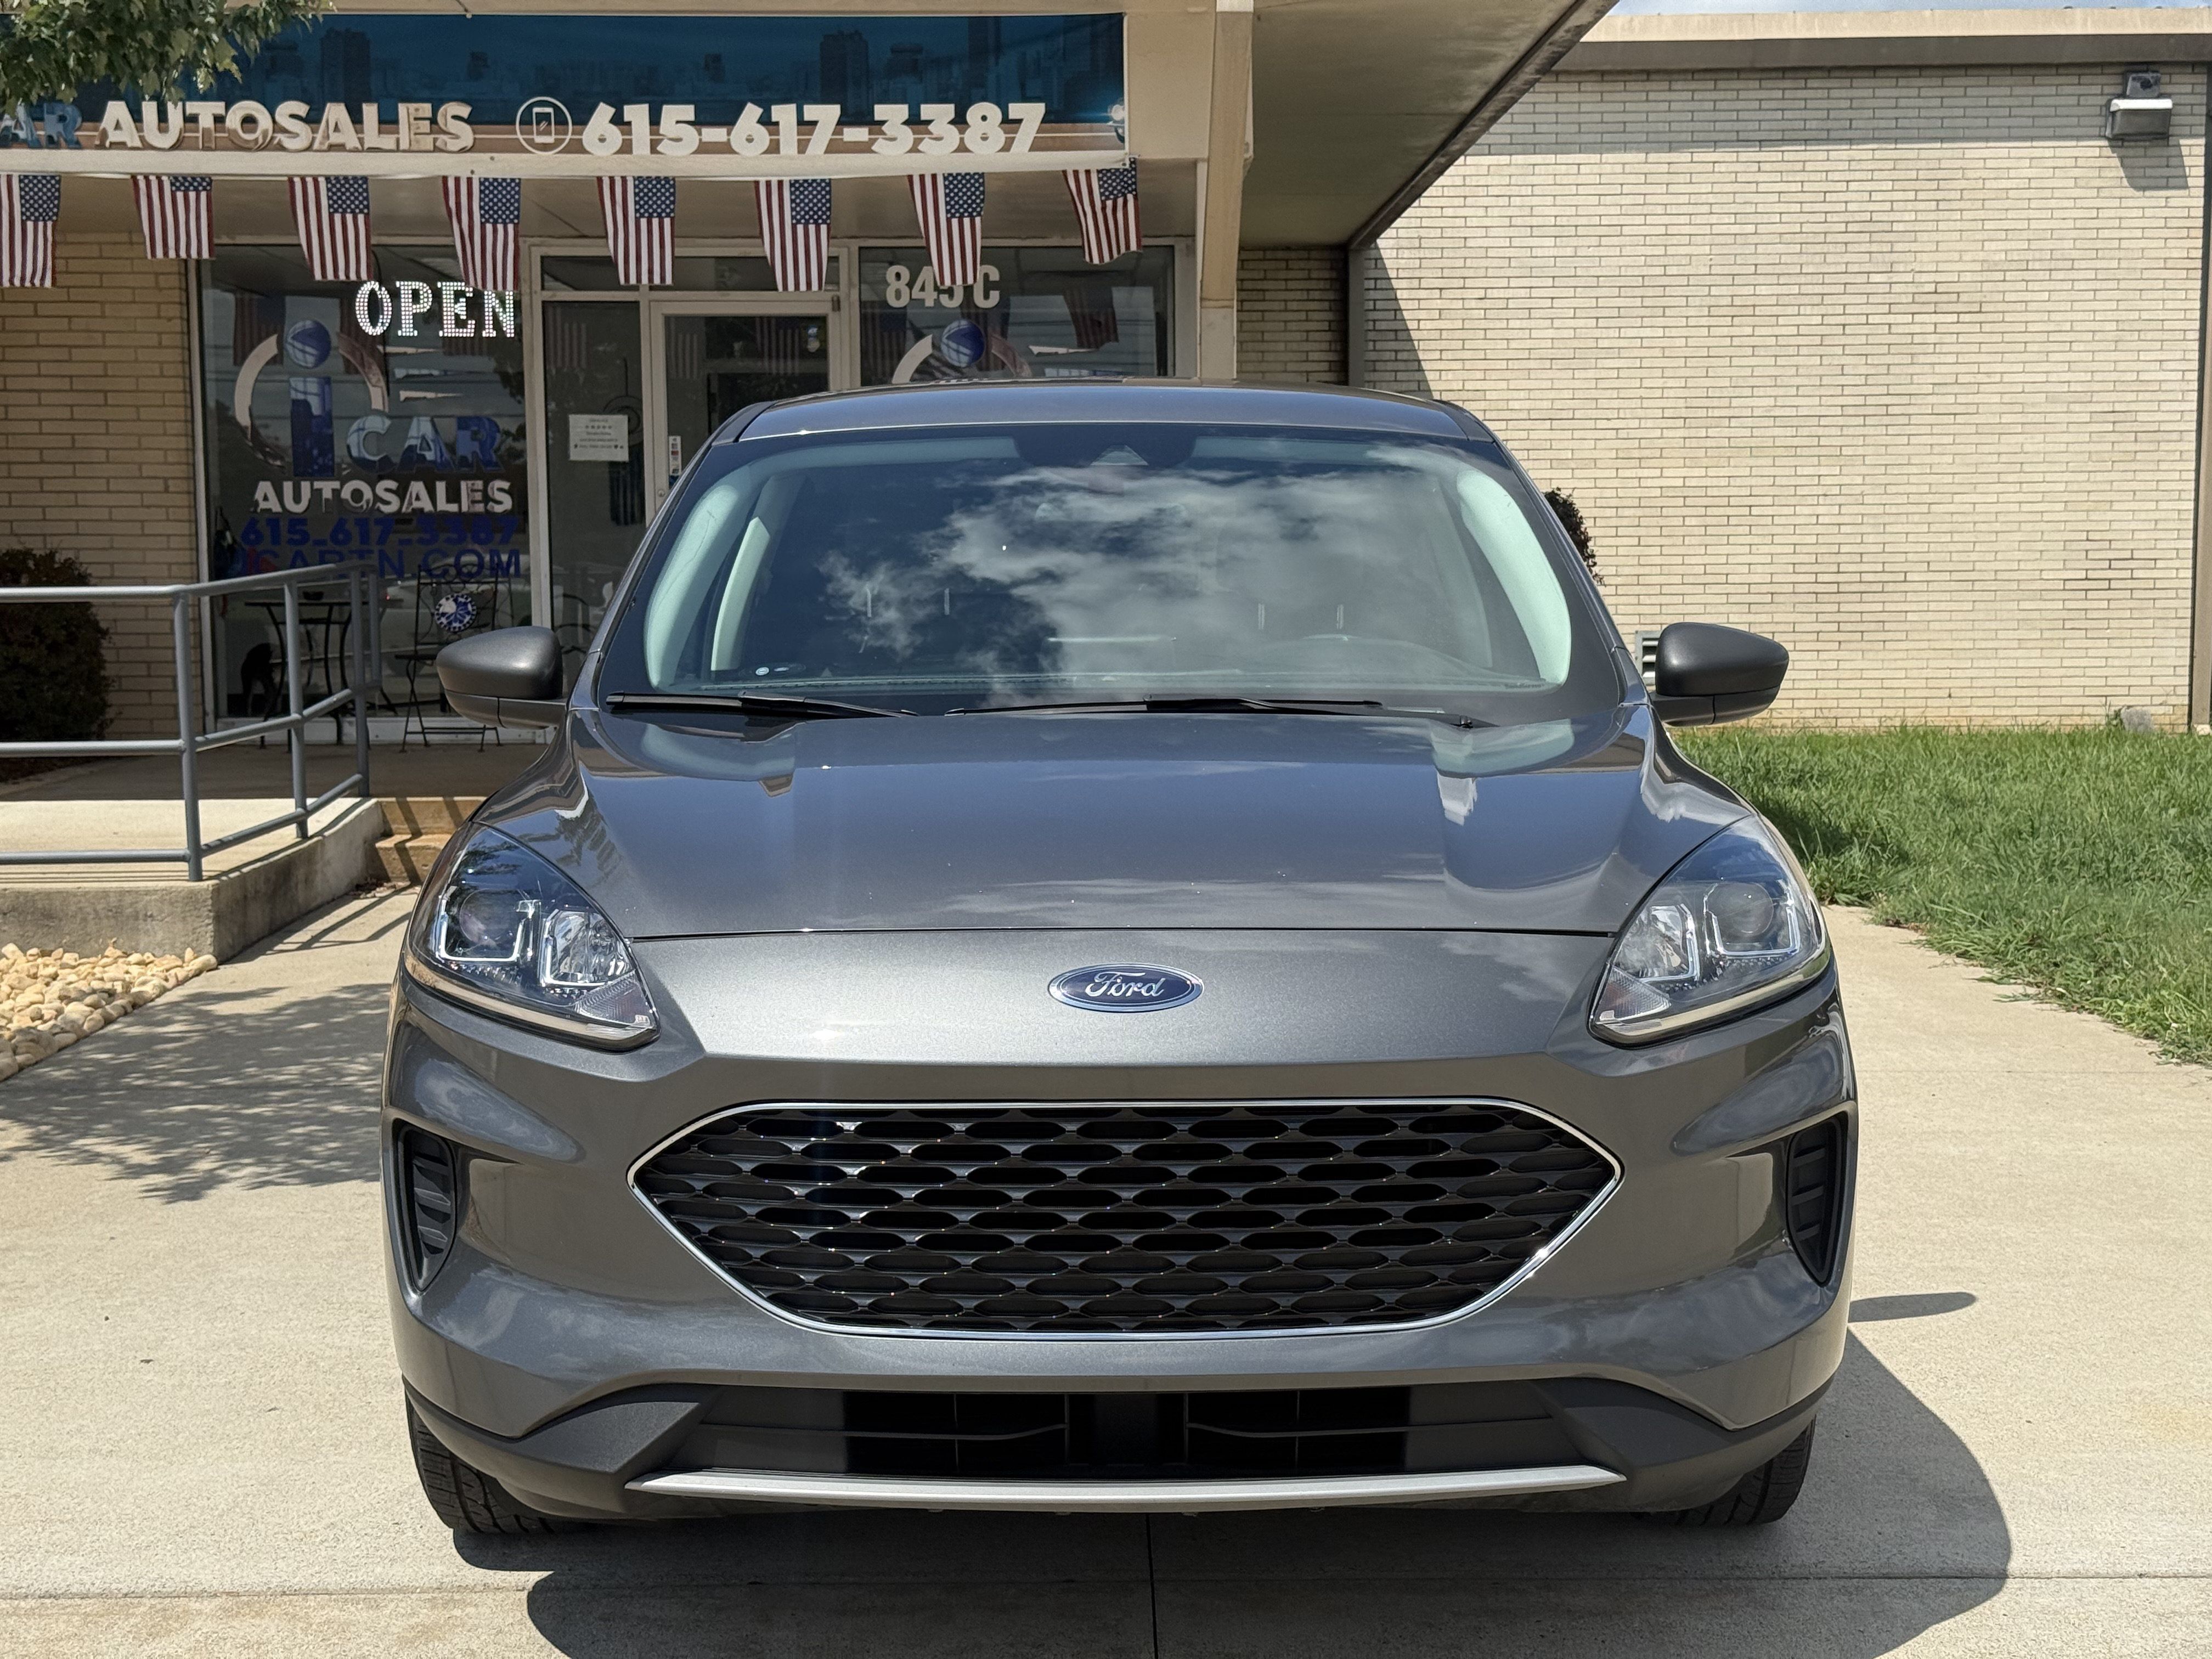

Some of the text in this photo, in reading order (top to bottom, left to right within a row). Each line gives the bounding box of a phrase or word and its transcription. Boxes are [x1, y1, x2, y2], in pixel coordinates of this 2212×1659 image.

[94, 100, 475, 152] AUTOSALES
[582, 101, 1046, 156] 615-617-3387
[973, 264, 1000, 308] C
[355, 280, 516, 337] OPEN
[251, 479, 514, 514] AUTOSALES
[1085, 970, 1166, 997] Ford
